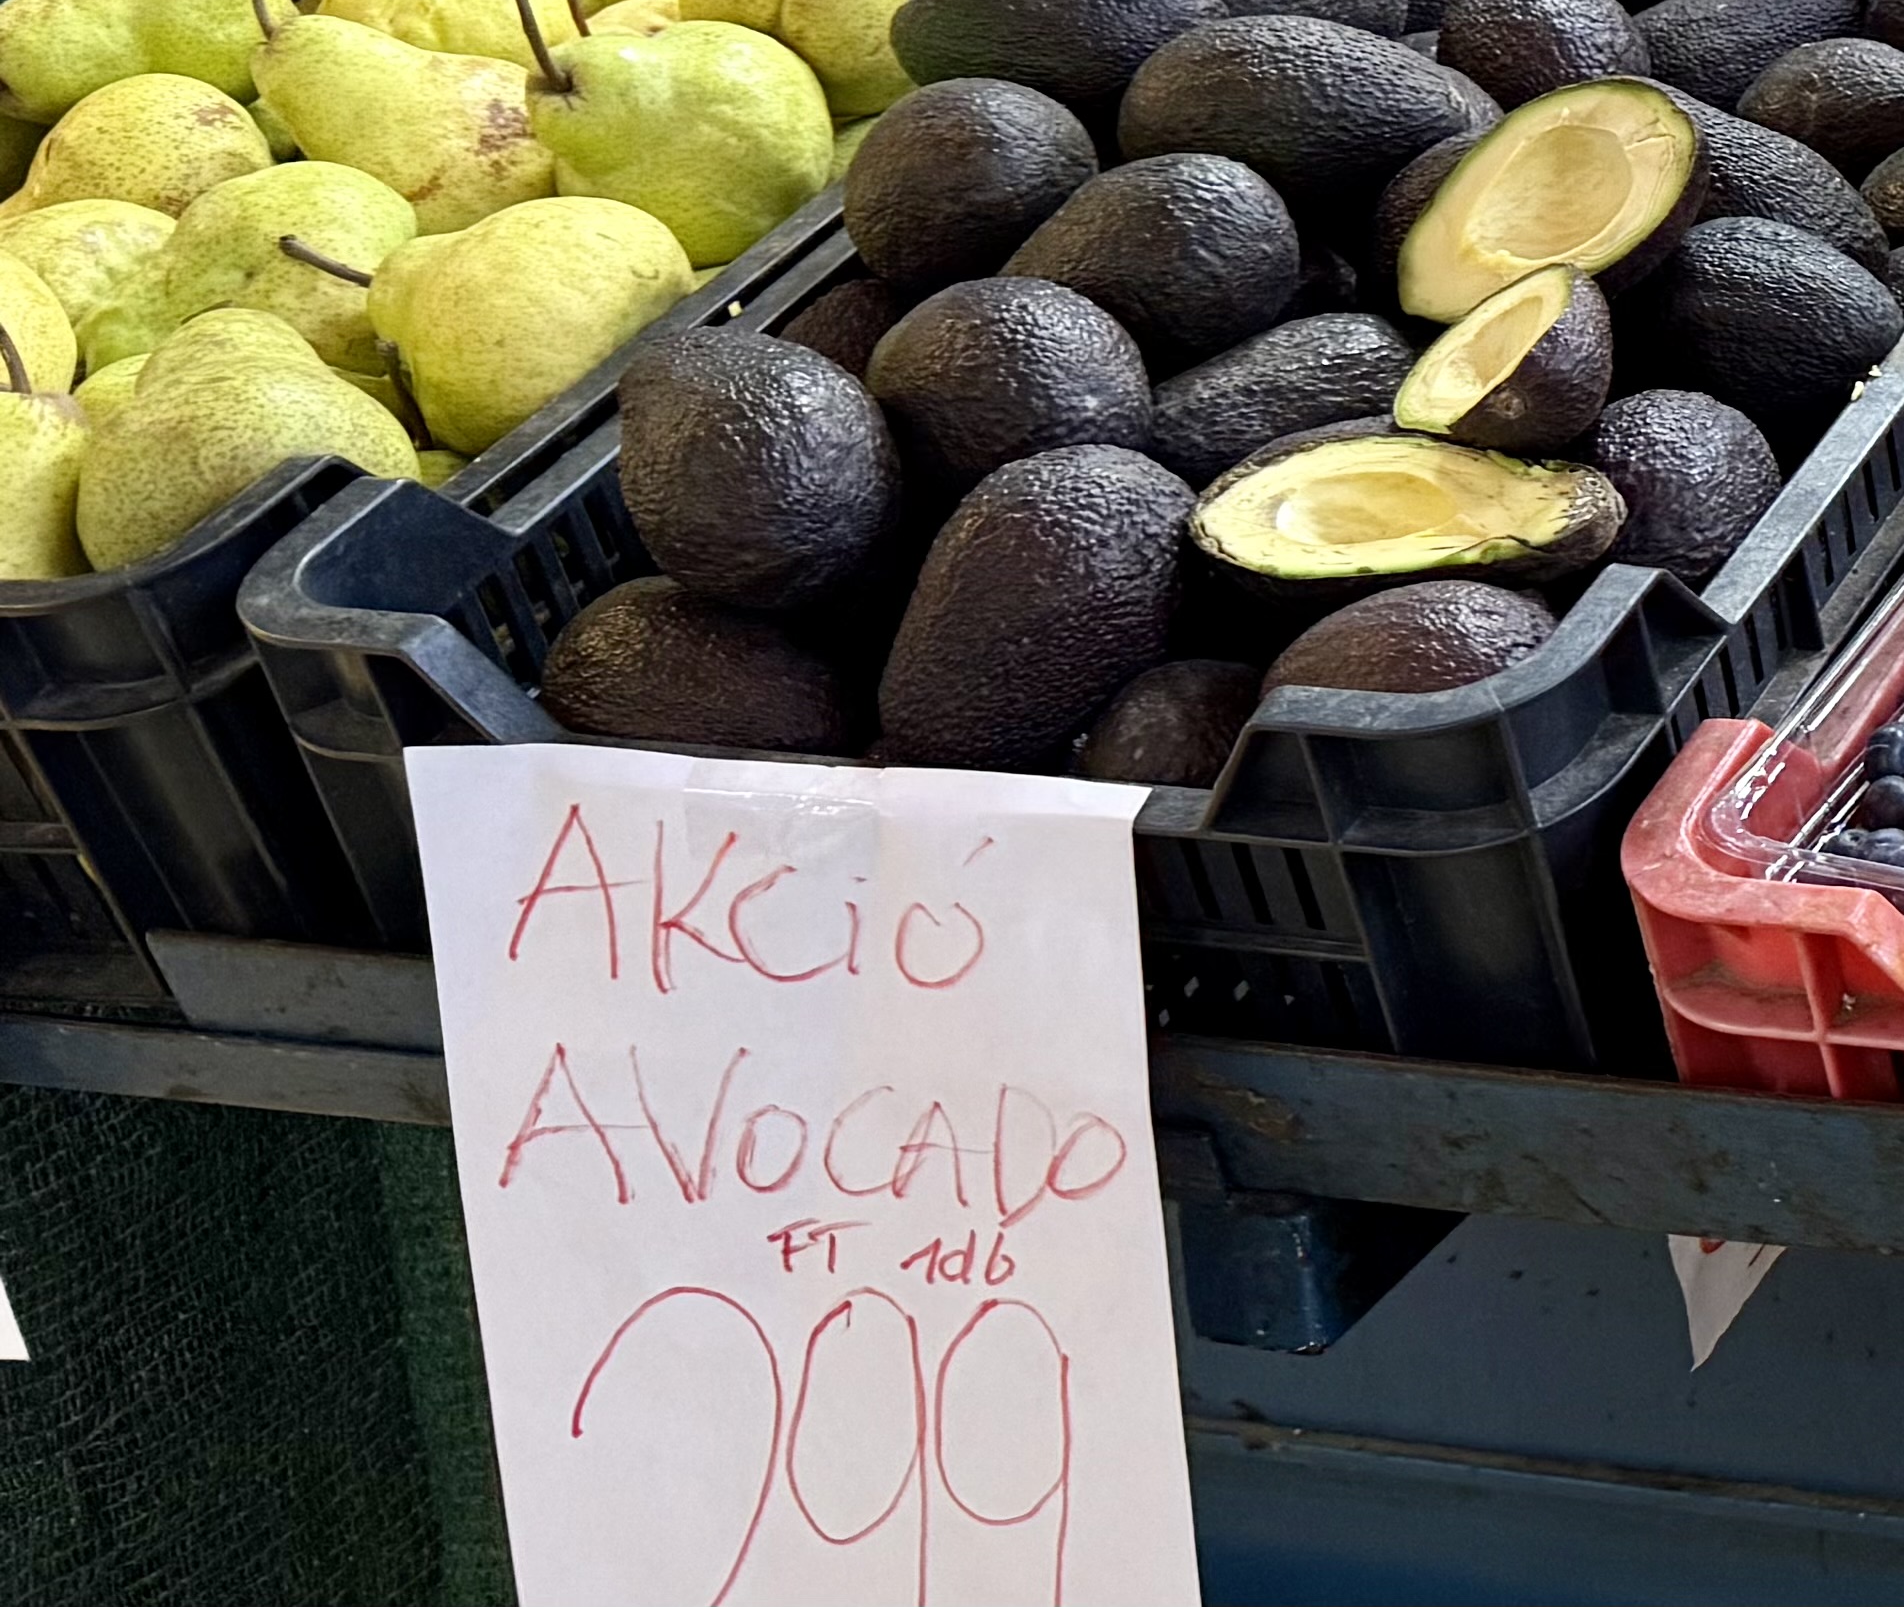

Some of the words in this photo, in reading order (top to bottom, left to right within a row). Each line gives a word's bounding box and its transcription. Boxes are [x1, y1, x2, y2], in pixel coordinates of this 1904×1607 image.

[499, 1042, 1127, 1227] AVOCADO
[767, 1217, 870, 1274] FT
[570, 1286, 1071, 1607] 299
